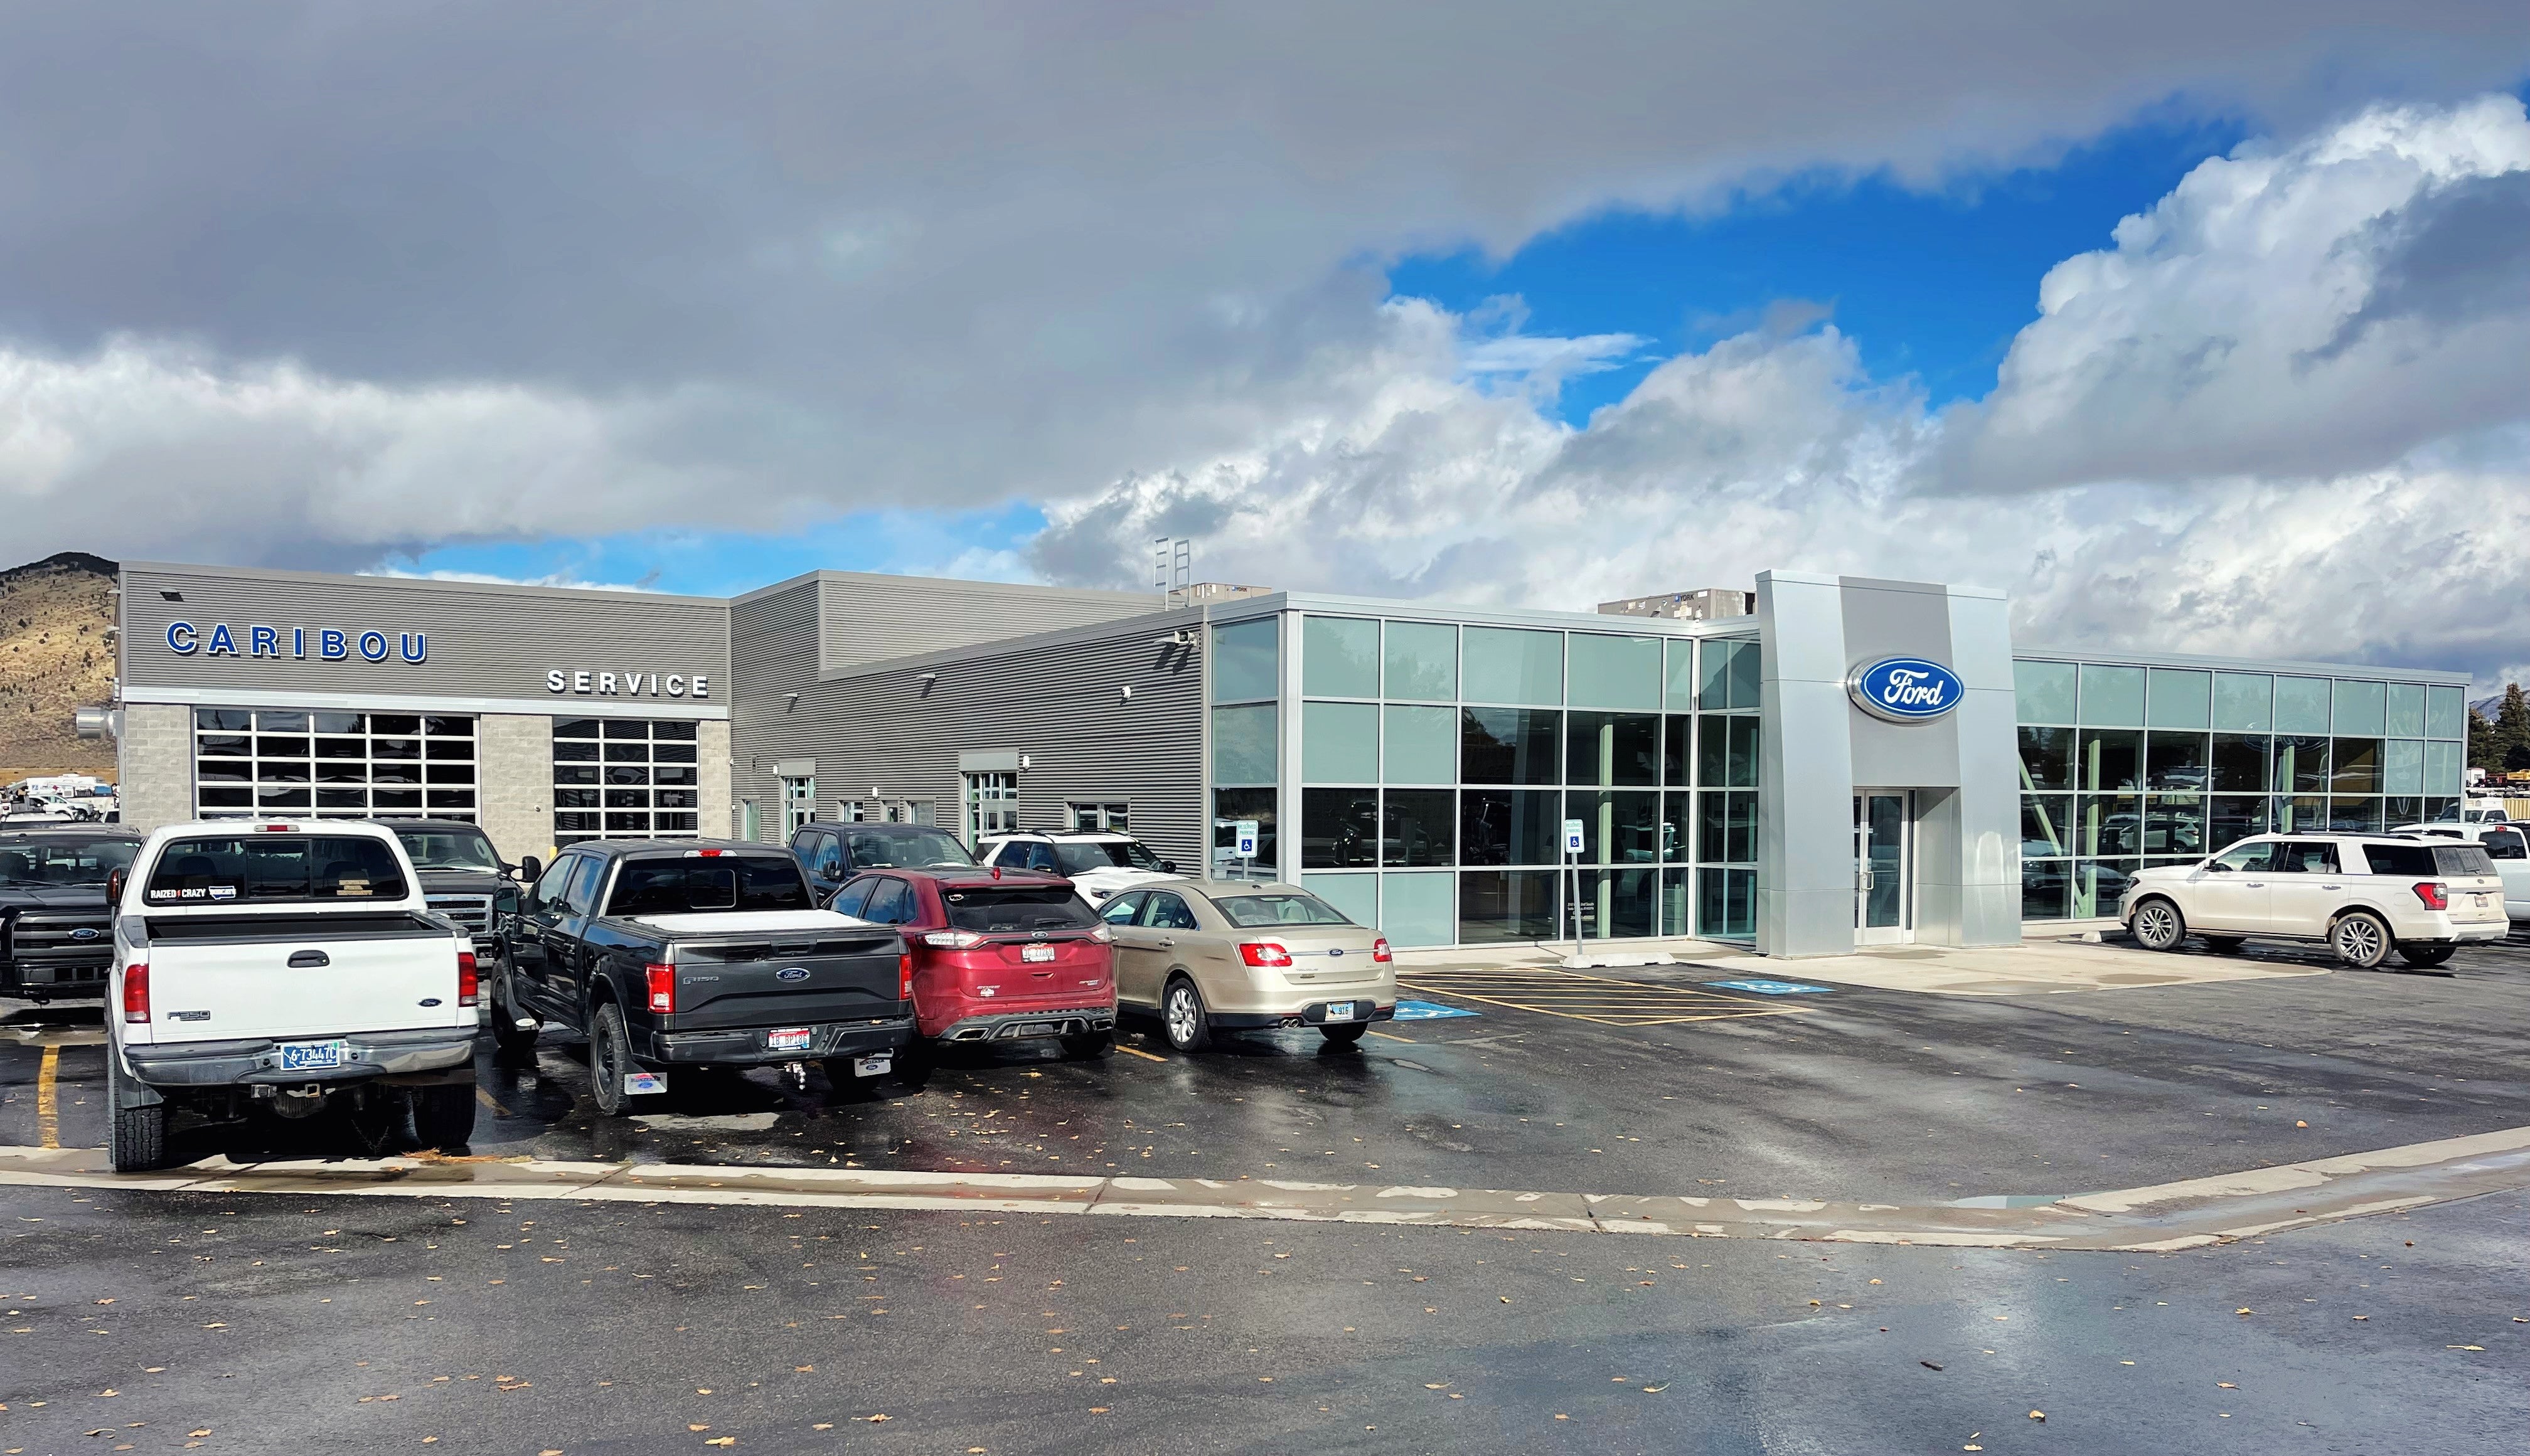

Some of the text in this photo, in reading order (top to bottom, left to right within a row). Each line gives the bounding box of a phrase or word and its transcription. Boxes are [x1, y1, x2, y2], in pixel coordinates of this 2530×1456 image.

[165, 620, 427, 663] CARIBOU
[547, 669, 708, 698] SERVICE
[1884, 669, 1944, 705] Ford
[151, 890, 176, 898] RAIZED
[182, 888, 206, 897] CRAZY
[291, 1047, 336, 1061] 6-73447C
